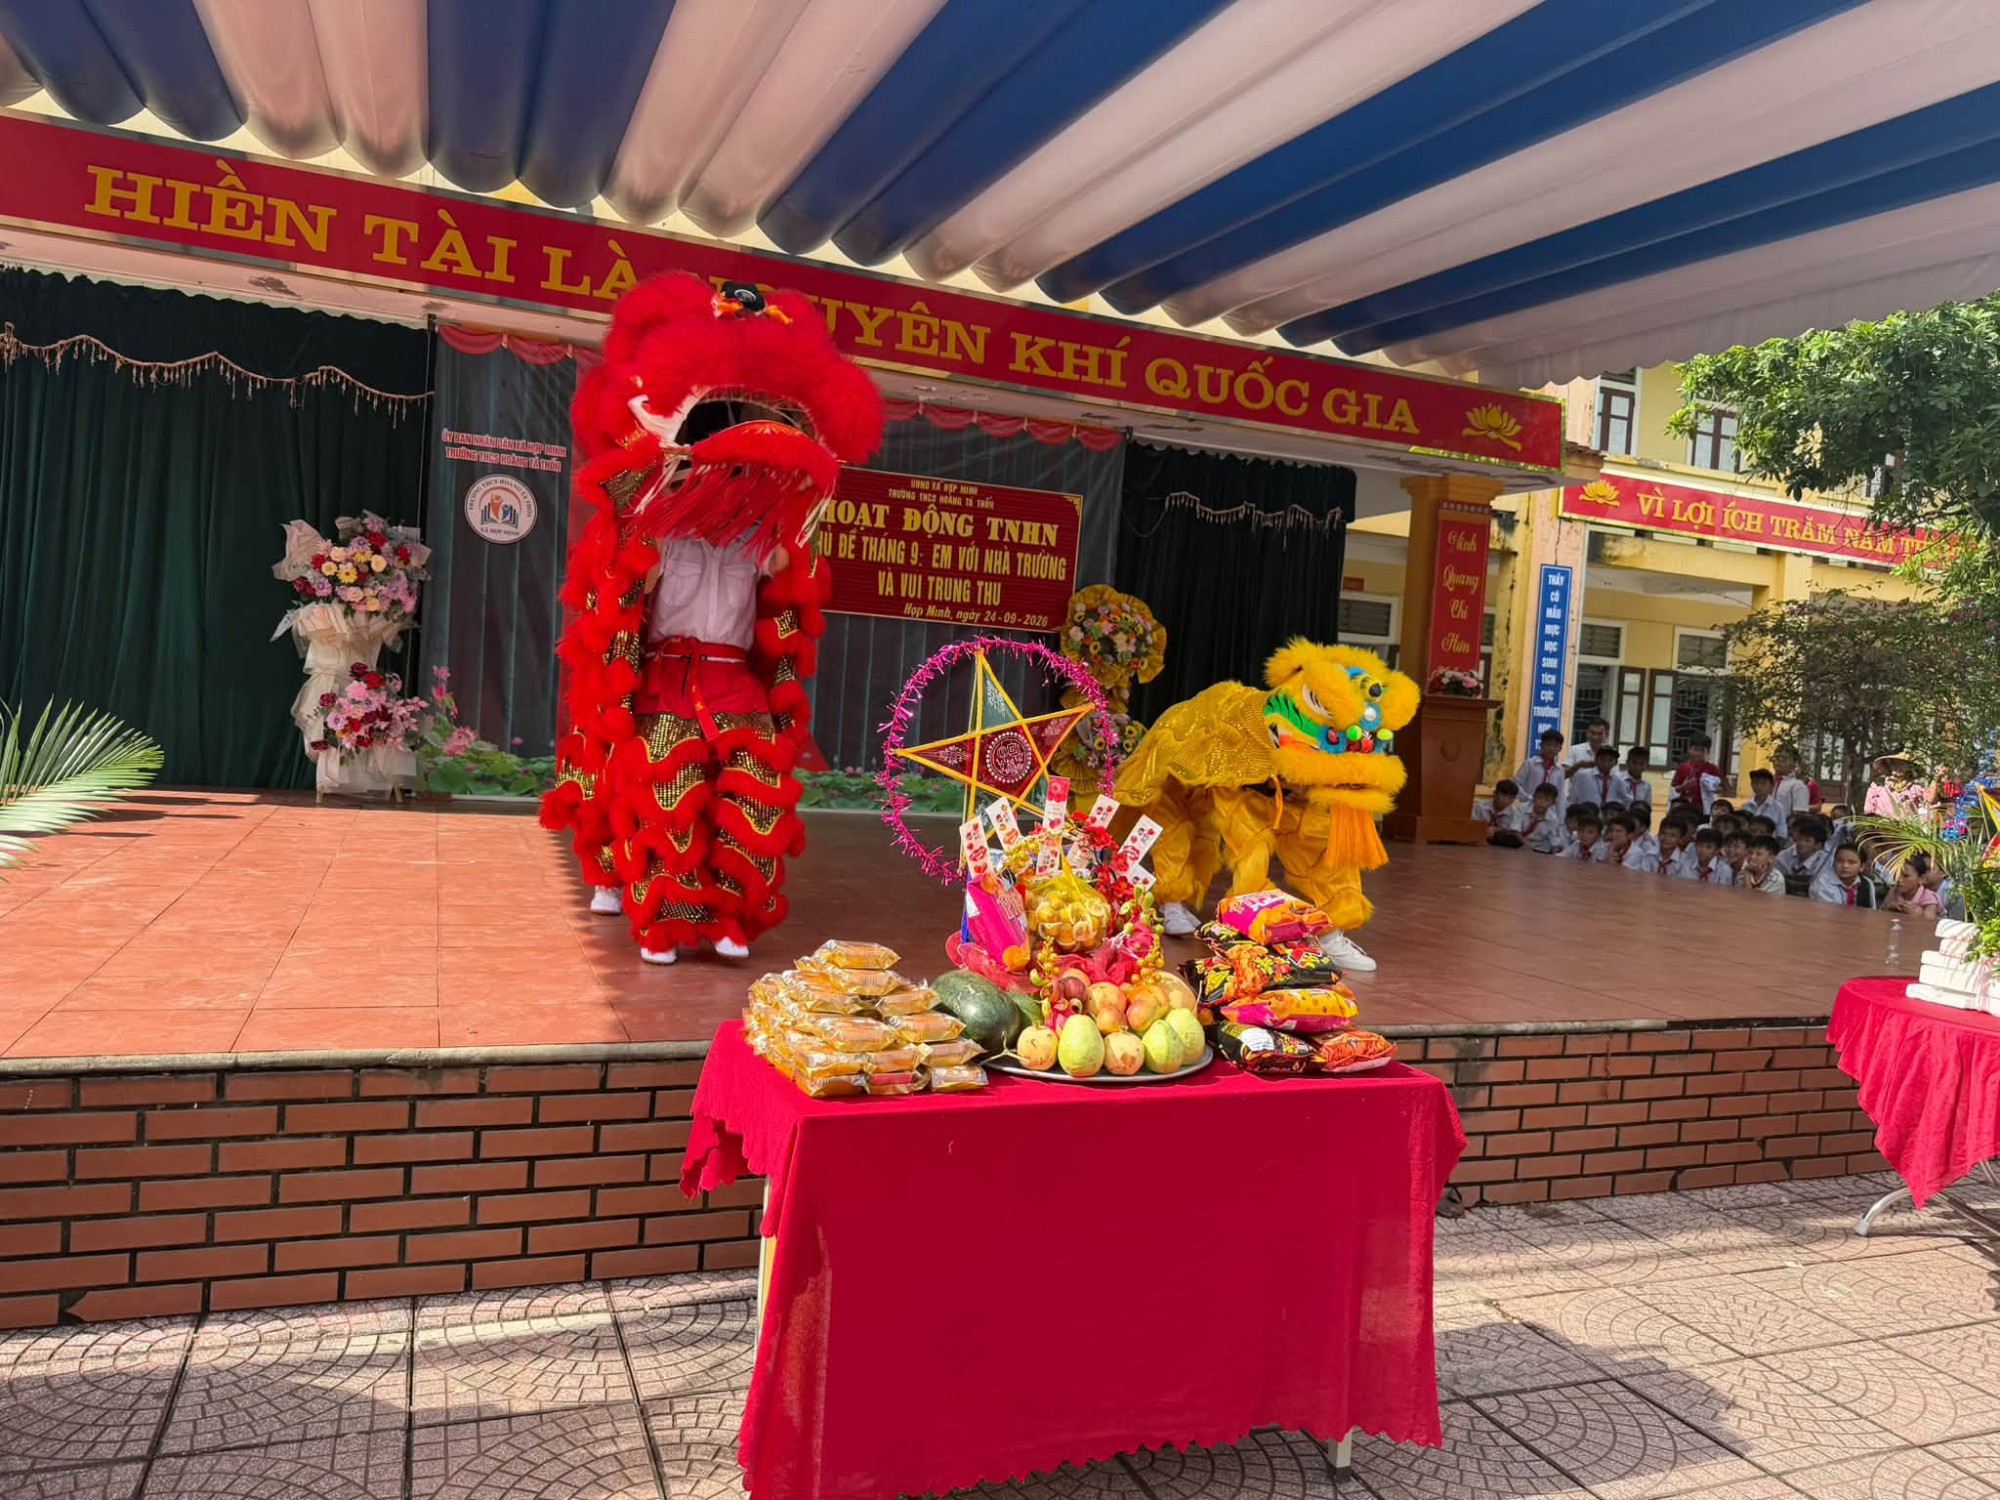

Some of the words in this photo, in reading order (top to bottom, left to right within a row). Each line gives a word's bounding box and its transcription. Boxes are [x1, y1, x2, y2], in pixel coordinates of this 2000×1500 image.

[84, 158, 337, 253] HIỀN
[363, 208, 518, 284] TÀI
[540, 238, 638, 300] LÀ
[1008, 332, 1131, 389] KHÍ
[1144, 356, 1310, 416] QUỐC
[1320, 387, 1420, 435] GIA
[445, 446, 478, 462] TRƯỜNG
[478, 450, 500, 464] THCS
[500, 452, 529, 469] HOÀNG
[454, 431, 473, 446] BAN
[472, 434, 497, 449] NHÂN
[544, 444, 567, 458] MINH
[919, 492, 937, 502] THCS
[939, 492, 962, 507] HOÀNG
[1637, 487, 1666, 519] VÌ
[1672, 499, 1715, 531] LỢI
[1721, 501, 1765, 534] ÍCH
[1769, 515, 1838, 546] TRĂM
[902, 502, 974, 539] ĐỘNG
[986, 516, 1060, 548] TNHN
[838, 528, 857, 560] ĐỀ
[862, 532, 906, 565] THÁNG
[932, 543, 953, 570] EM
[958, 540, 980, 572] VỚI
[983, 545, 1011, 576] NHÀ
[1016, 548, 1067, 581] TRƯỜNG
[877, 566, 895, 597] VÀ
[900, 572, 923, 600] VUI
[927, 575, 971, 603] TRUNG
[977, 580, 1002, 607] THU
[1442, 563, 1481, 594] Quang
[903, 602, 924, 619] Hợp
[955, 608, 981, 624] ngày
